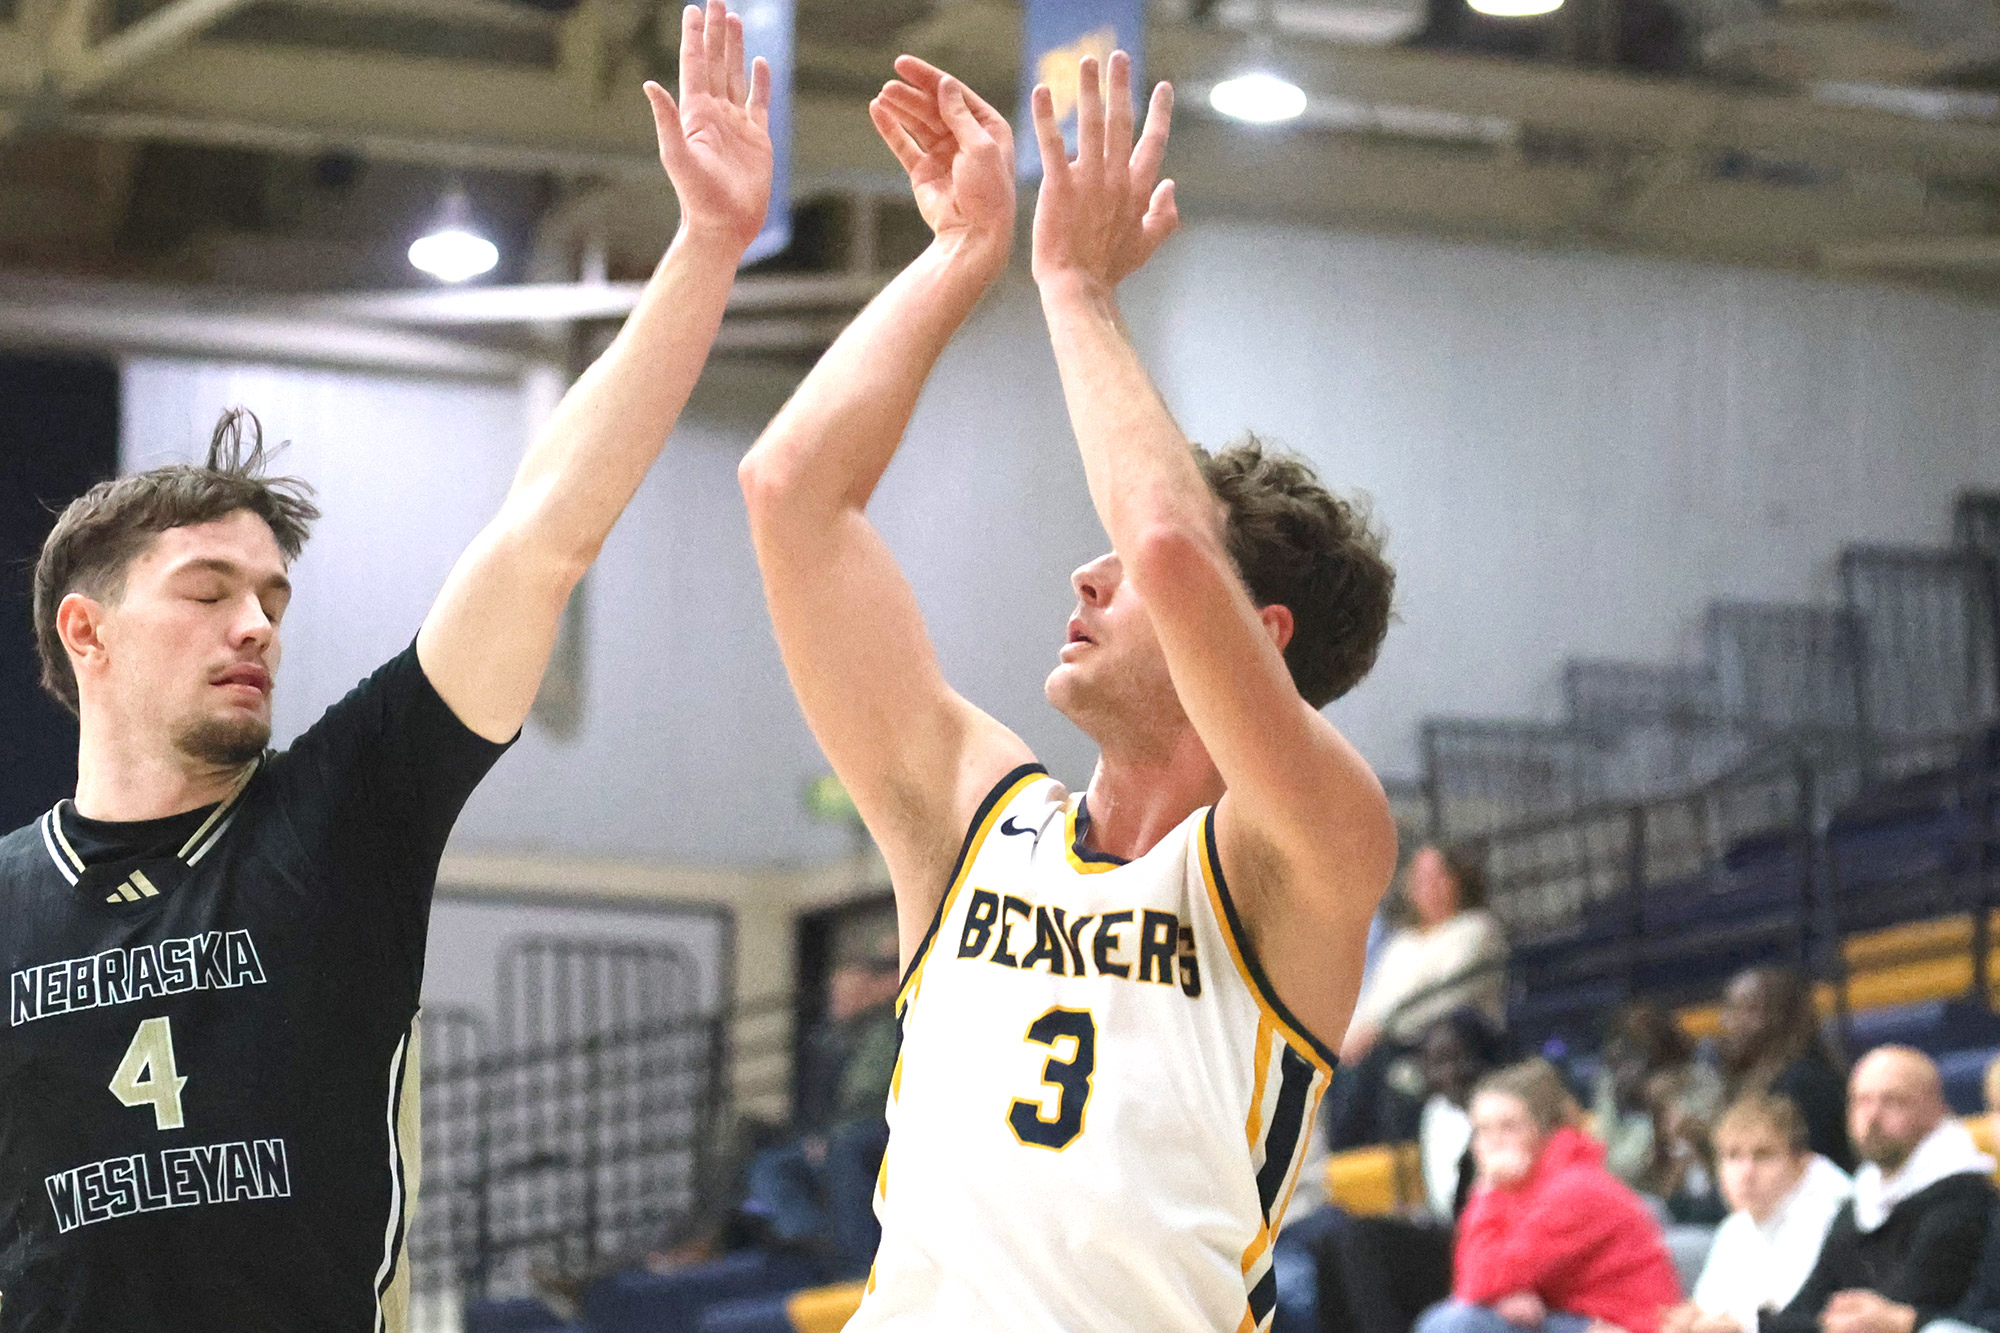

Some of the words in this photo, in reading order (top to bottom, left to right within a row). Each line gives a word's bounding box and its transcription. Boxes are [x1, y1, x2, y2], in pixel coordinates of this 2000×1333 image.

[11, 929, 267, 1026] NEBRASKA
[108, 1016, 188, 1130] 4
[1005, 1004, 1098, 1153] 3
[45, 1139, 291, 1234] WESLEYAN
